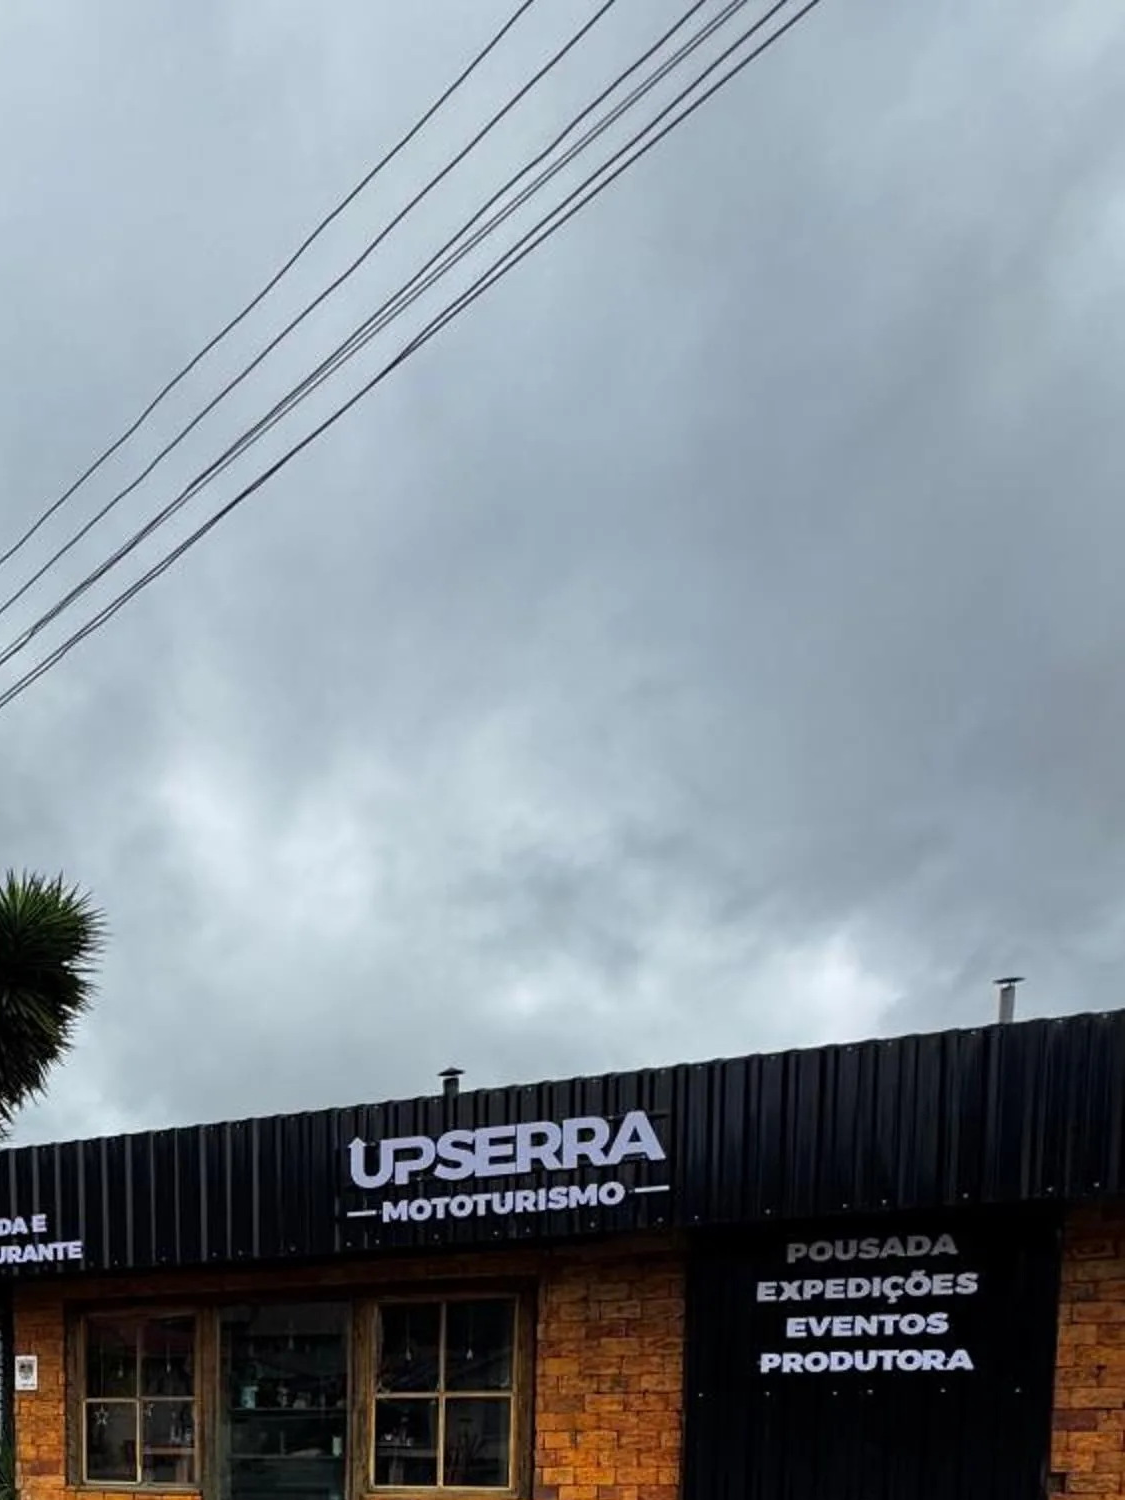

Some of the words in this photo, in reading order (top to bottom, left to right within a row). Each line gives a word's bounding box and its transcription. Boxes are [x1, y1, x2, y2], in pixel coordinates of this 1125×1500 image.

[382, 1181, 626, 1223] MOTOTURISMO
[32, 1214, 47, 1232] E
[786, 1234, 958, 1263] POUSADA
[756, 1269, 979, 1303] EXPEDIÇÕES
[786, 1312, 950, 1338] EVENTOS
[759, 1349, 975, 1374] PRODUTORA
